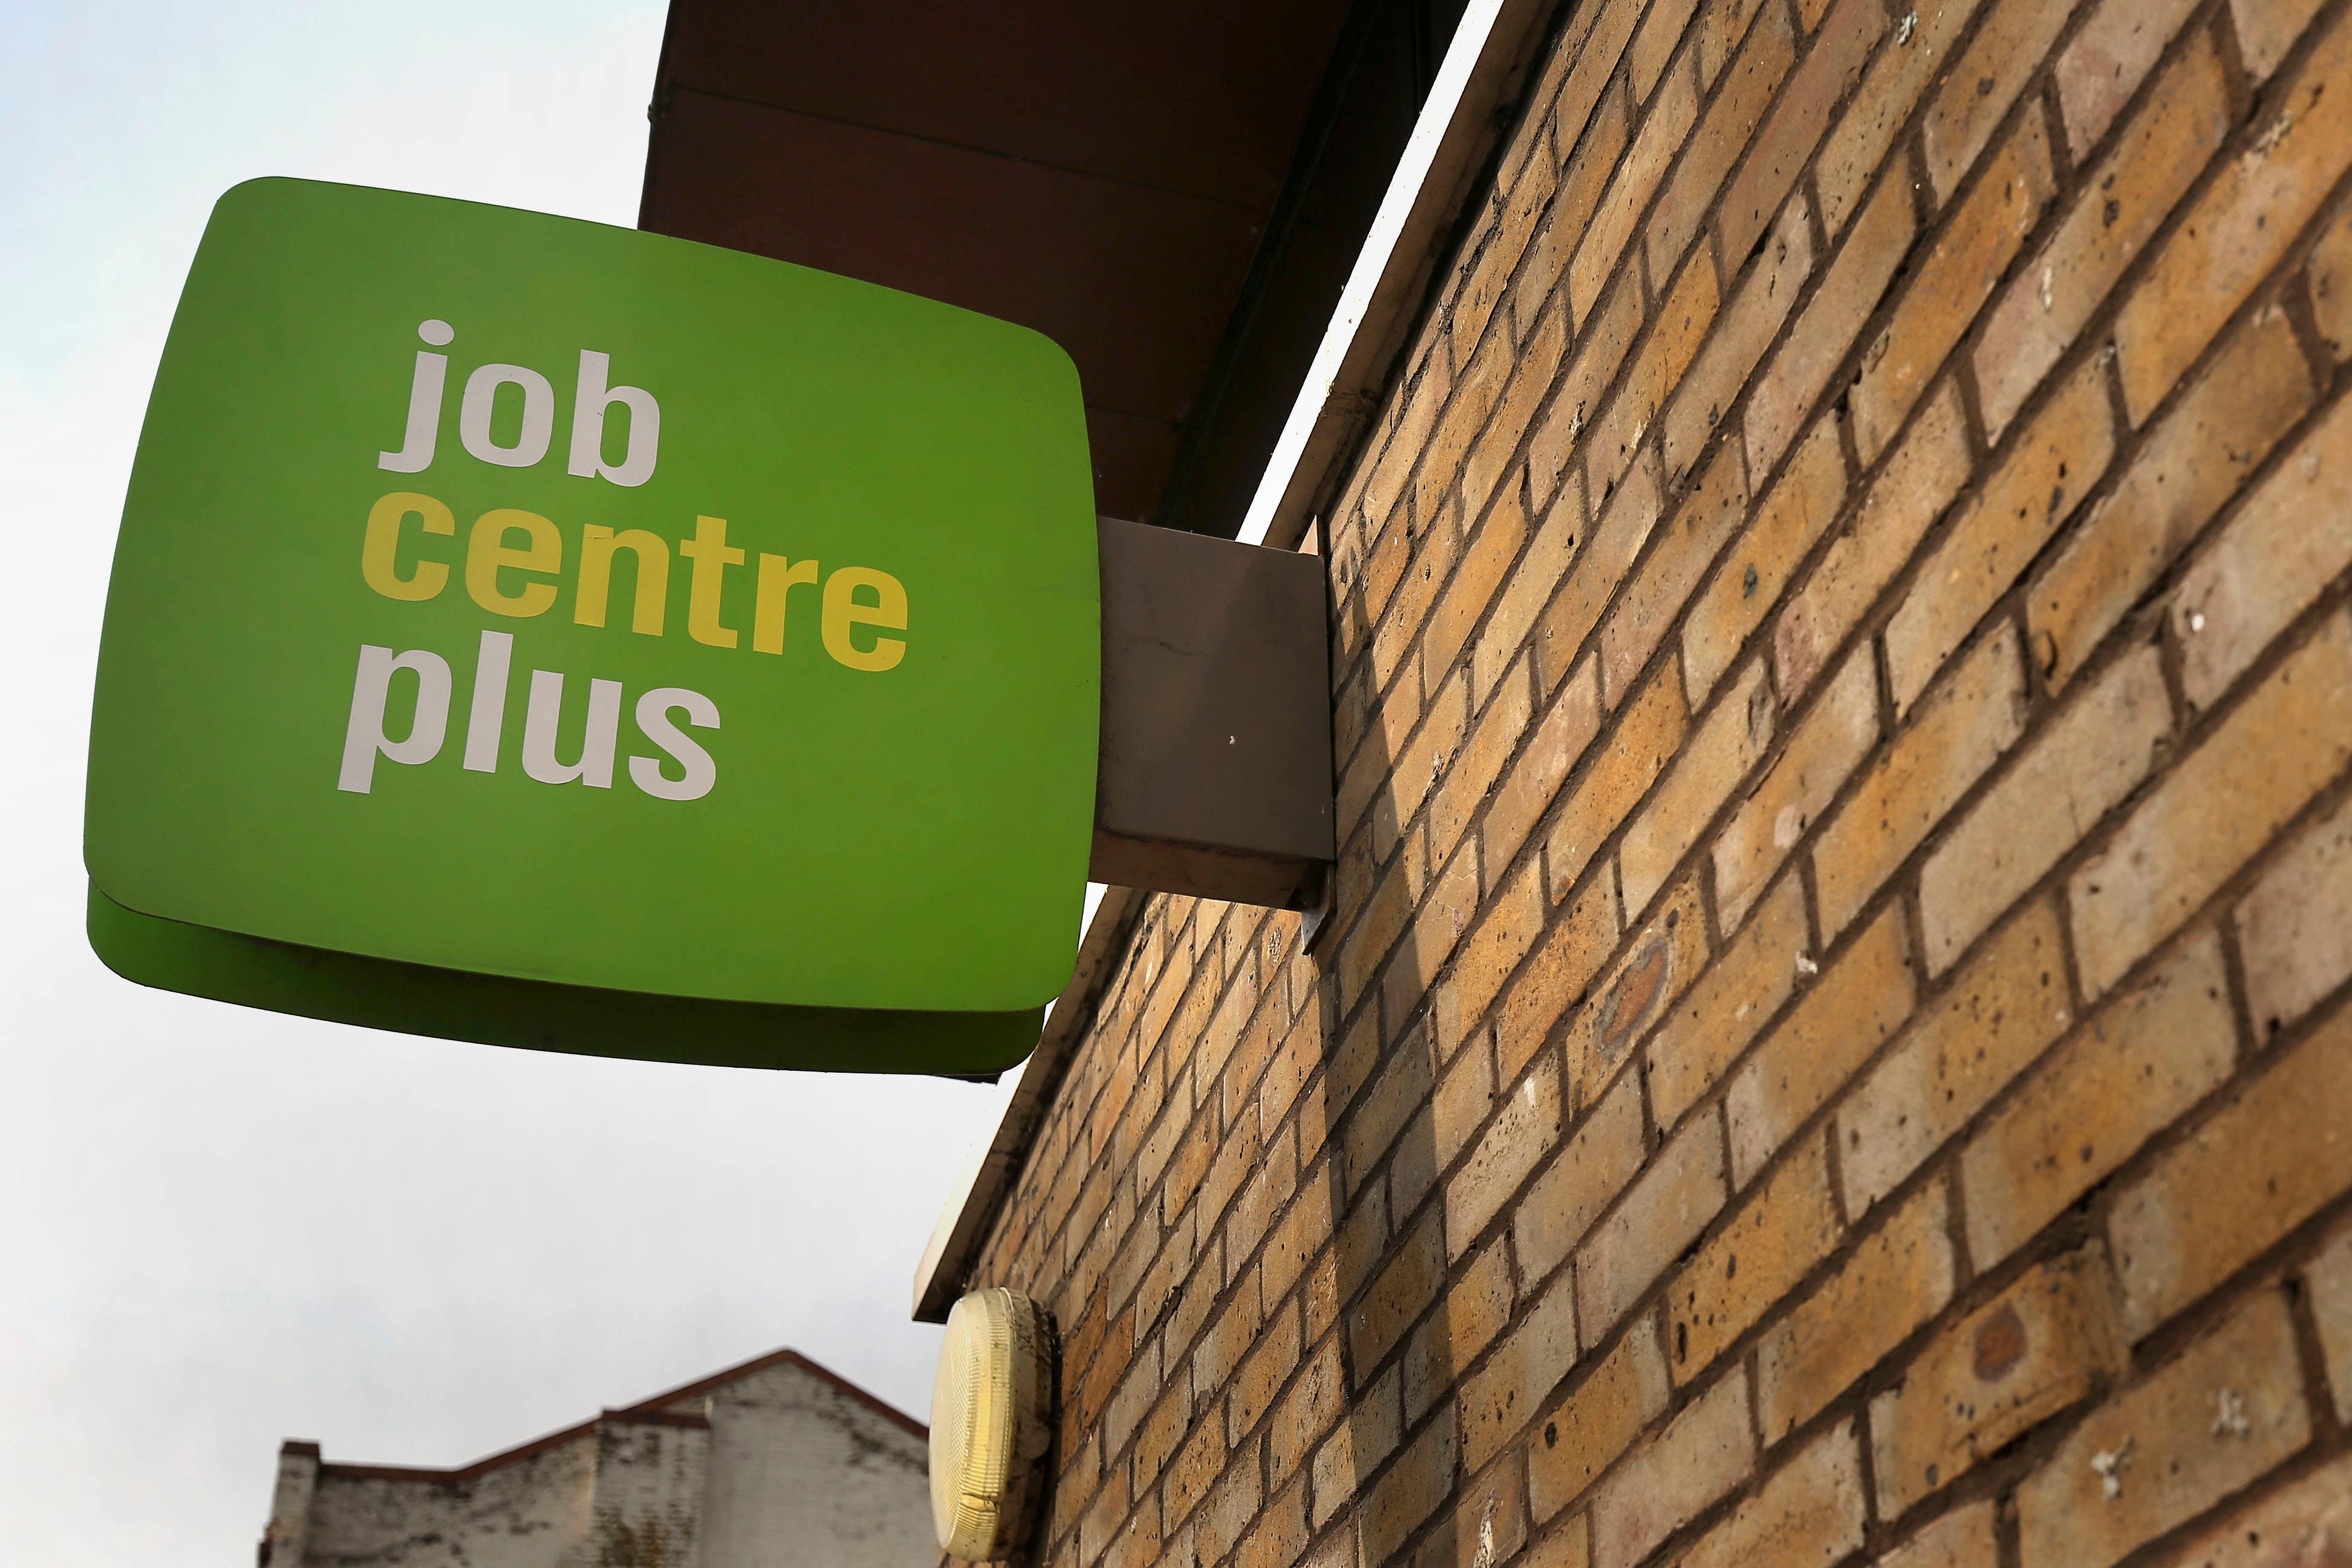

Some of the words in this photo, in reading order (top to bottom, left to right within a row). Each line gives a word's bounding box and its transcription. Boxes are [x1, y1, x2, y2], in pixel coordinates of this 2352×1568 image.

[377, 319, 660, 487] job
[362, 492, 909, 672] centre
[337, 629, 722, 802] plus
